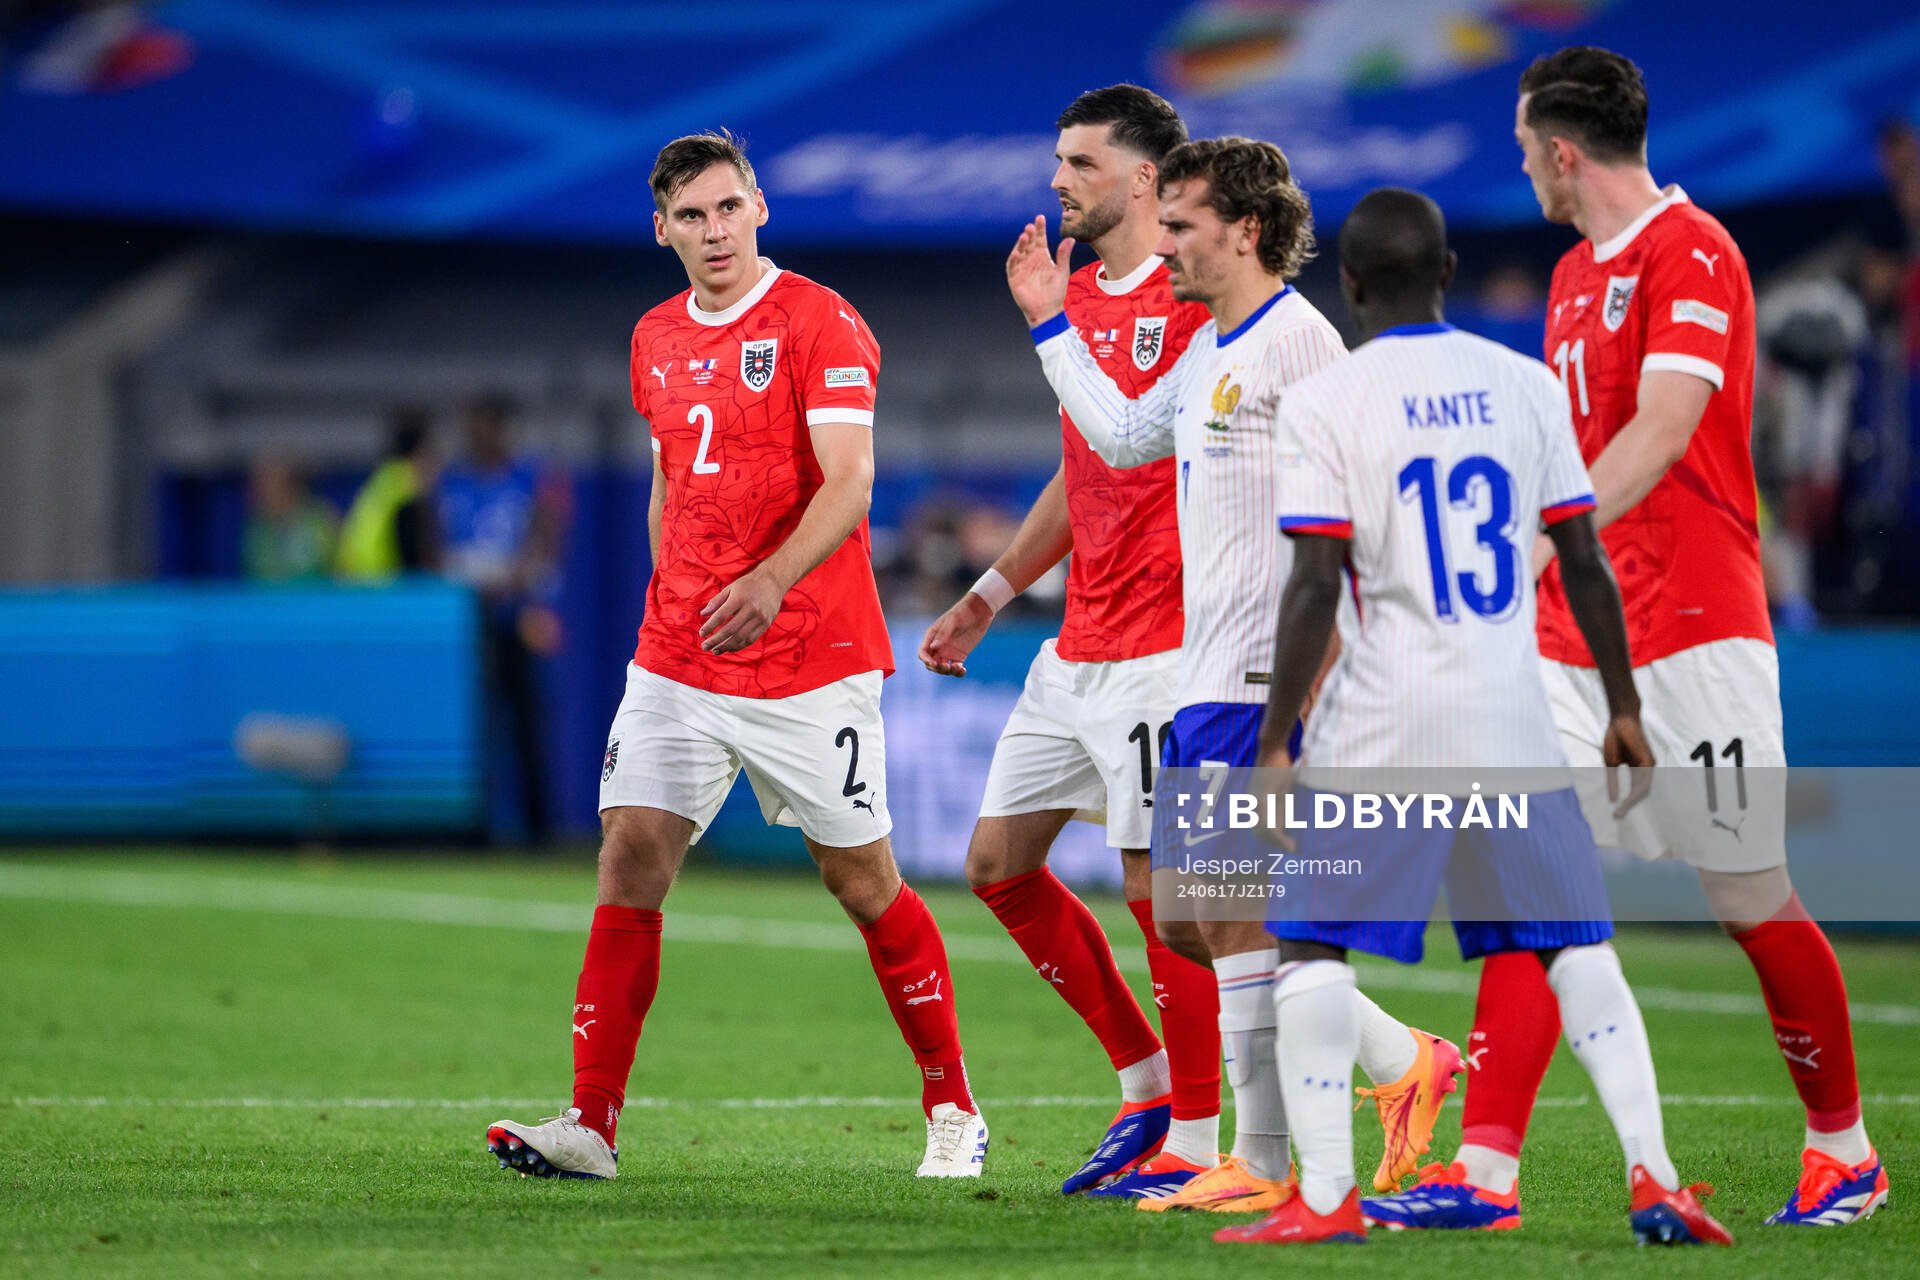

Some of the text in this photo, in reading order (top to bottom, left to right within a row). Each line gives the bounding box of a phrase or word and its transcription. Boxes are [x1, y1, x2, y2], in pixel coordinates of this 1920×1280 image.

[687, 404, 721, 475] 2
[1403, 391, 1495, 429] KANTE
[1398, 455, 1523, 624] 13
[835, 726, 866, 797] 2
[1195, 760, 1230, 827] 7
[1690, 737, 1748, 813] 11
